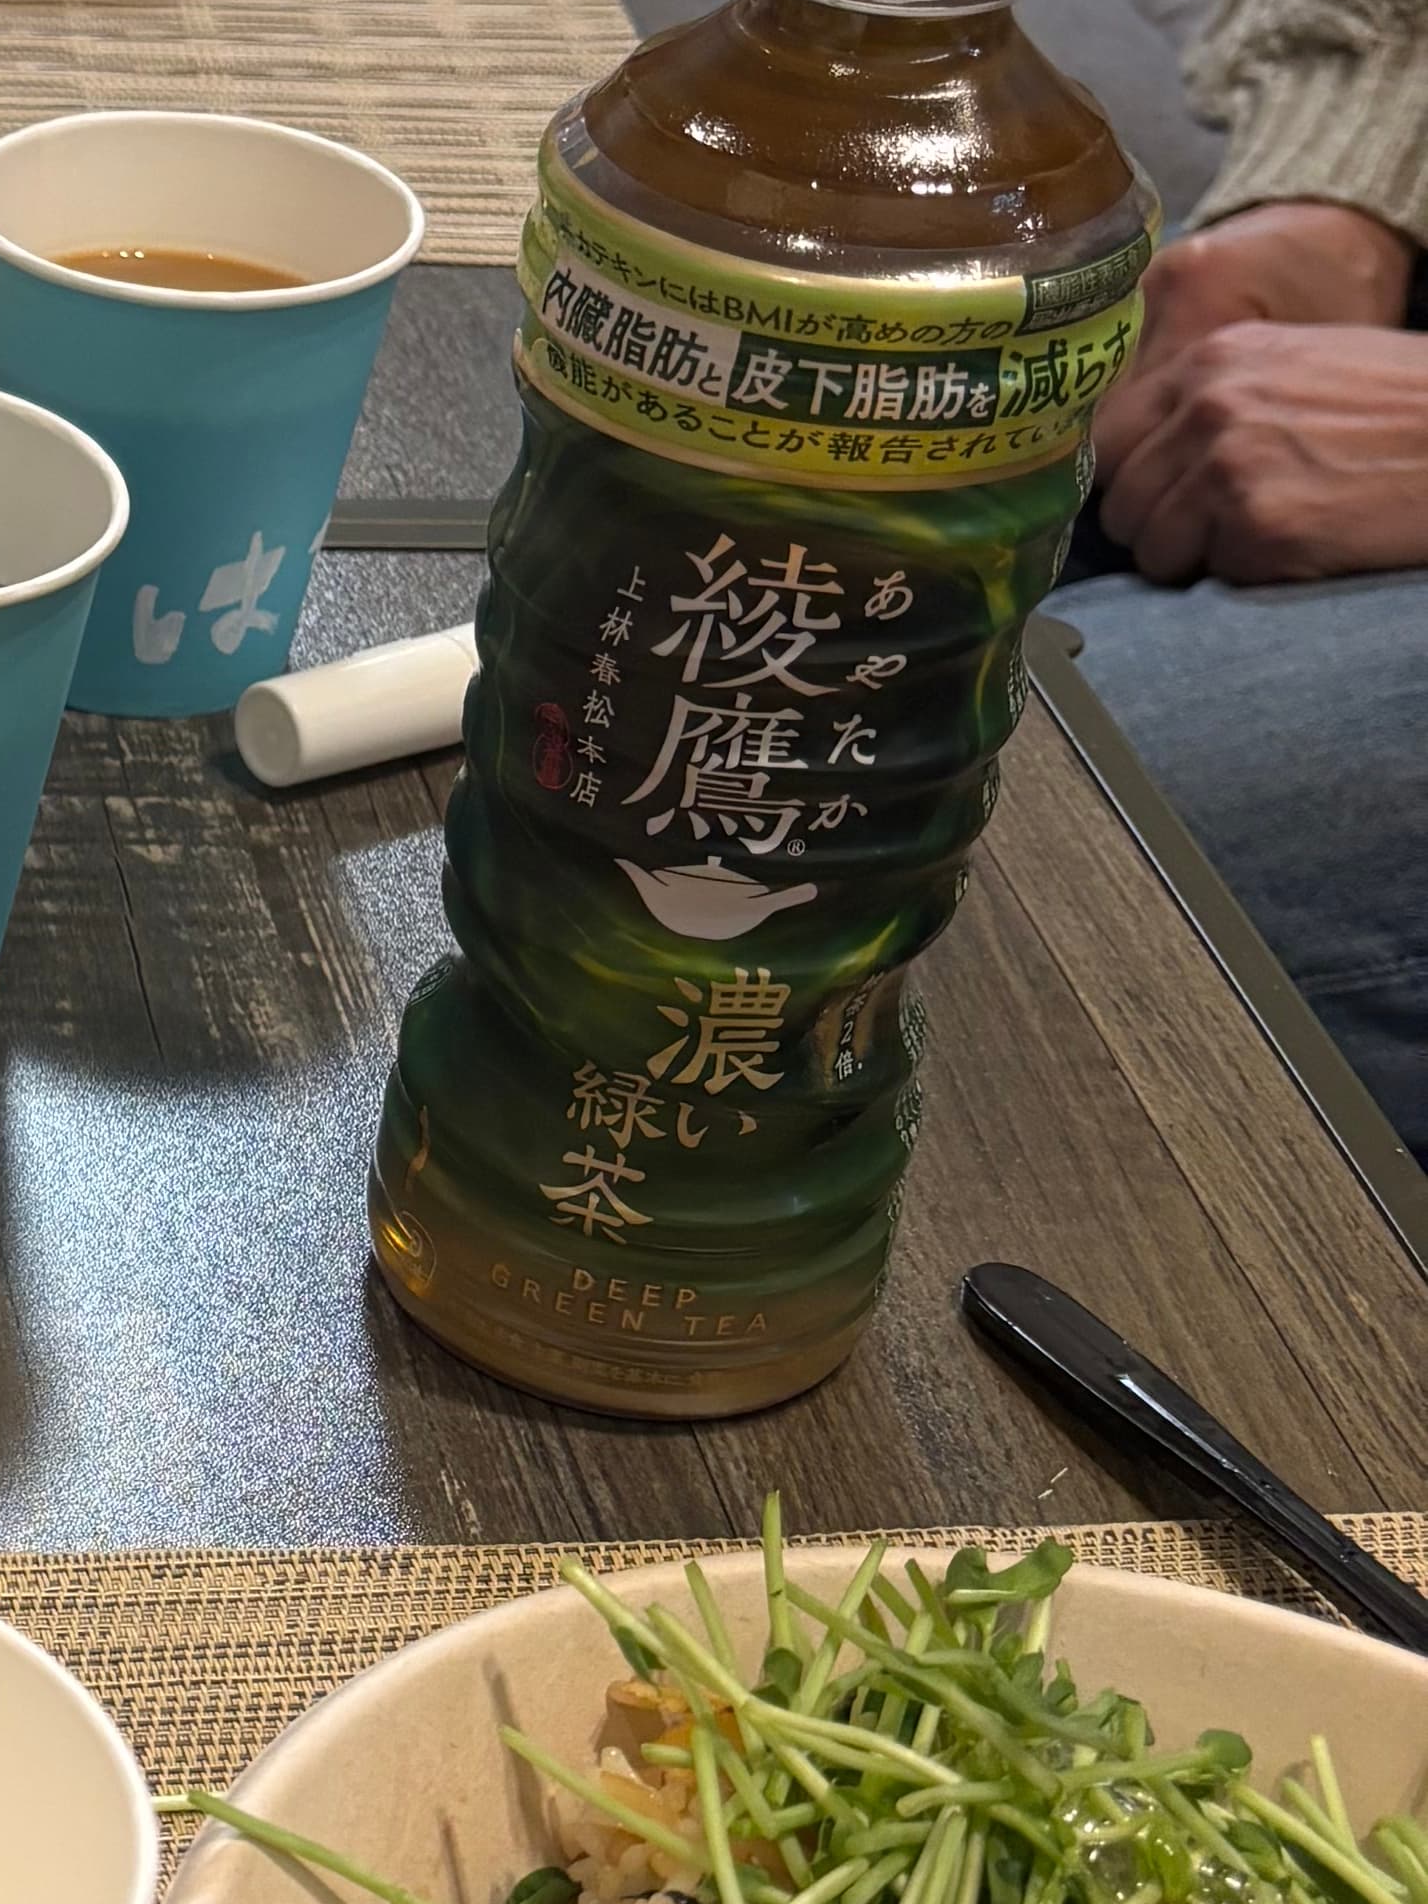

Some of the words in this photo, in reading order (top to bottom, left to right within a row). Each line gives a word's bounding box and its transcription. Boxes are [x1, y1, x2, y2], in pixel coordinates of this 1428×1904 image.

[569, 565, 646, 808] 上林春松本店
[620, 533, 845, 855] 綾鷹
[807, 569, 914, 833] あやたか
[539, 1059, 668, 1245] 緑茶
[491, 1262, 645, 1332] GREEN
[683, 1312, 768, 1337] TEA
[572, 1266, 698, 1311] DEEP
